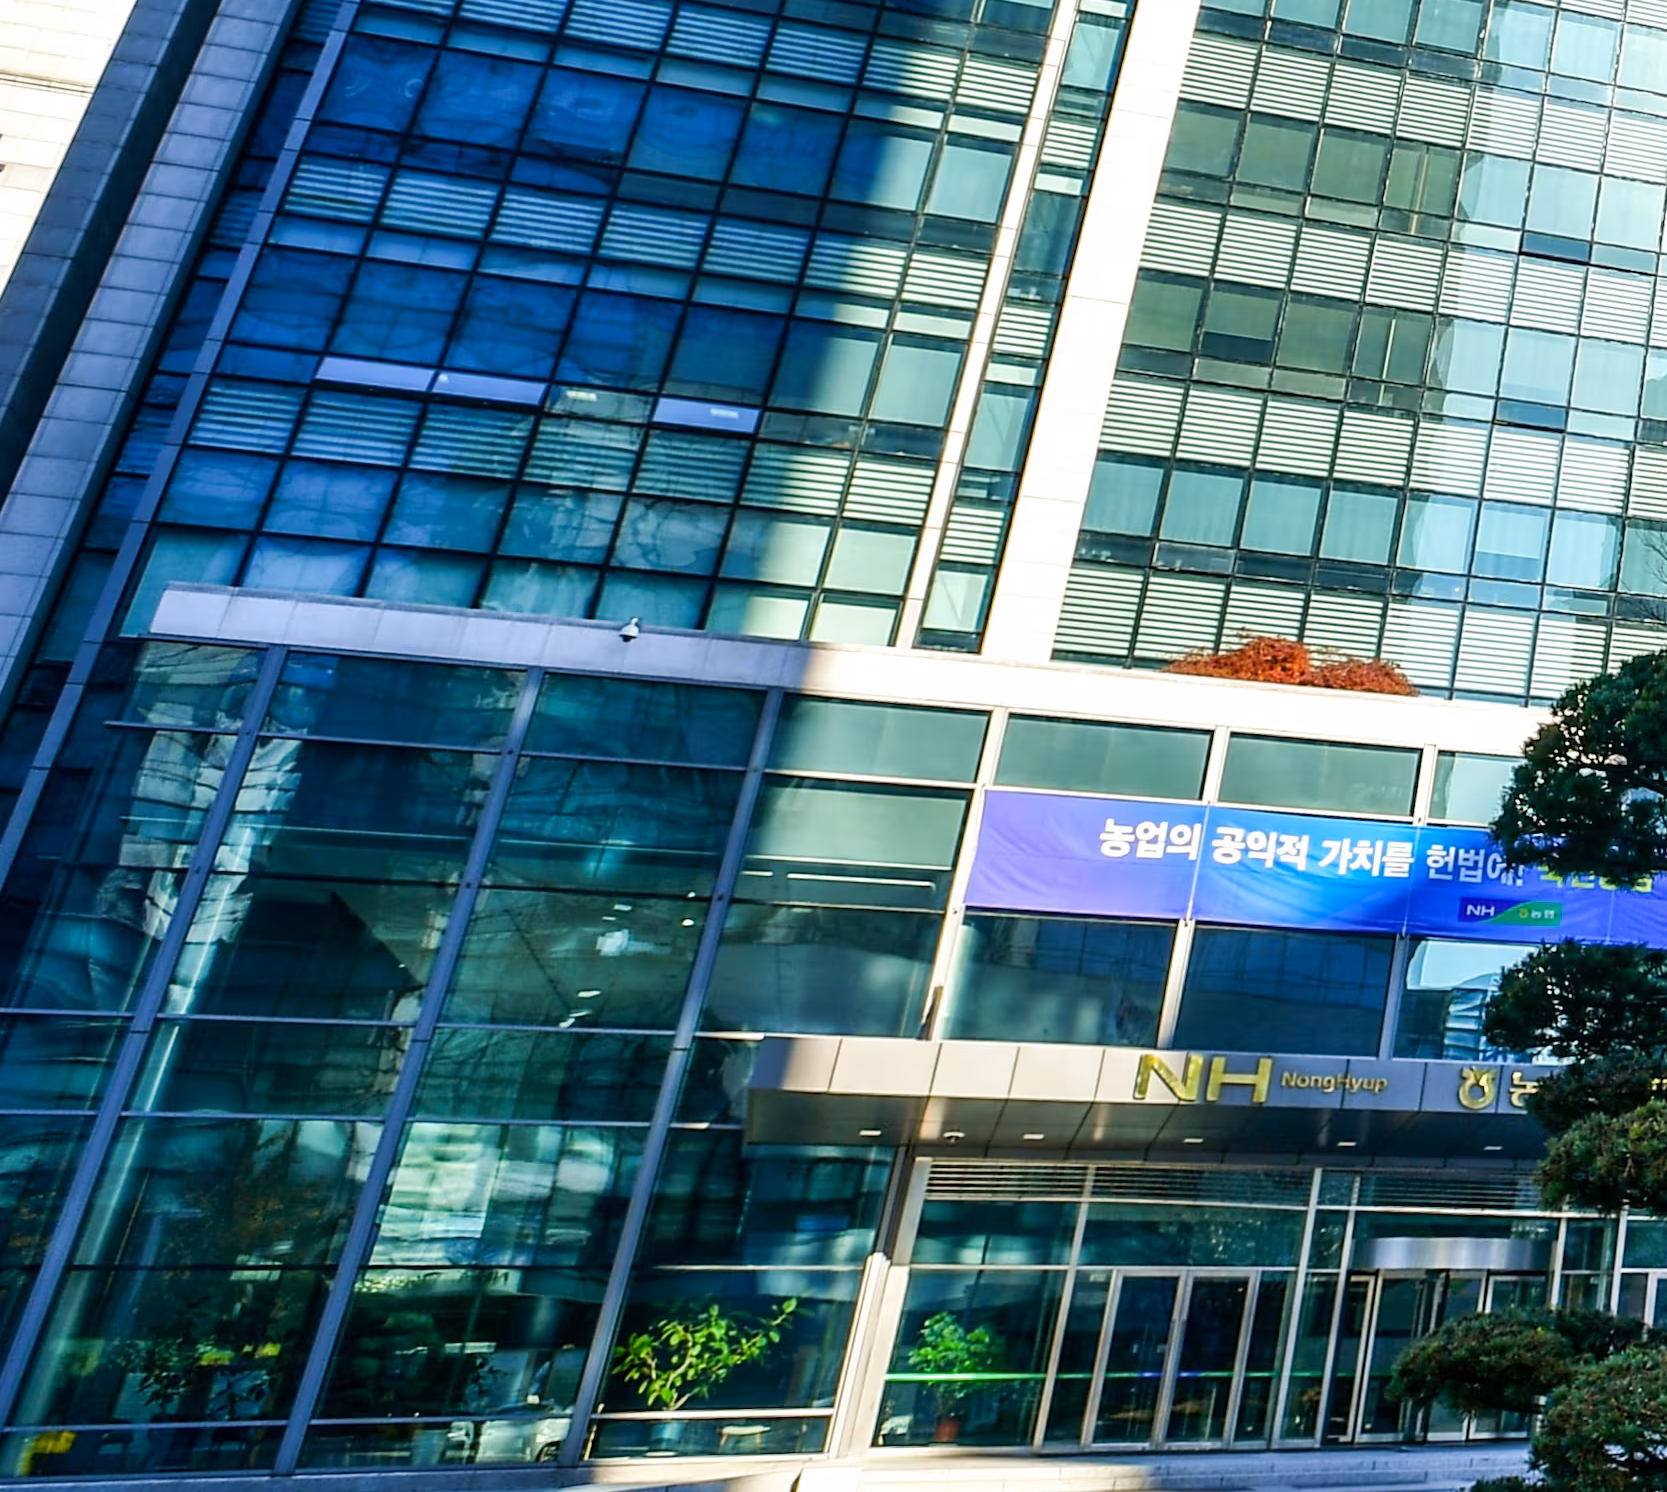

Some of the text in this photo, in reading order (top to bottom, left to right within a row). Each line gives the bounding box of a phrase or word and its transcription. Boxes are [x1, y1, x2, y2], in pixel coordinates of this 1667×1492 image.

[1099, 817, 1202, 860] 농업의
[1212, 826, 1309, 871] 공익적
[1316, 838, 1414, 878] 가치를
[1465, 903, 1496, 917] NH
[1133, 1053, 1389, 1103] NH NongHyup
